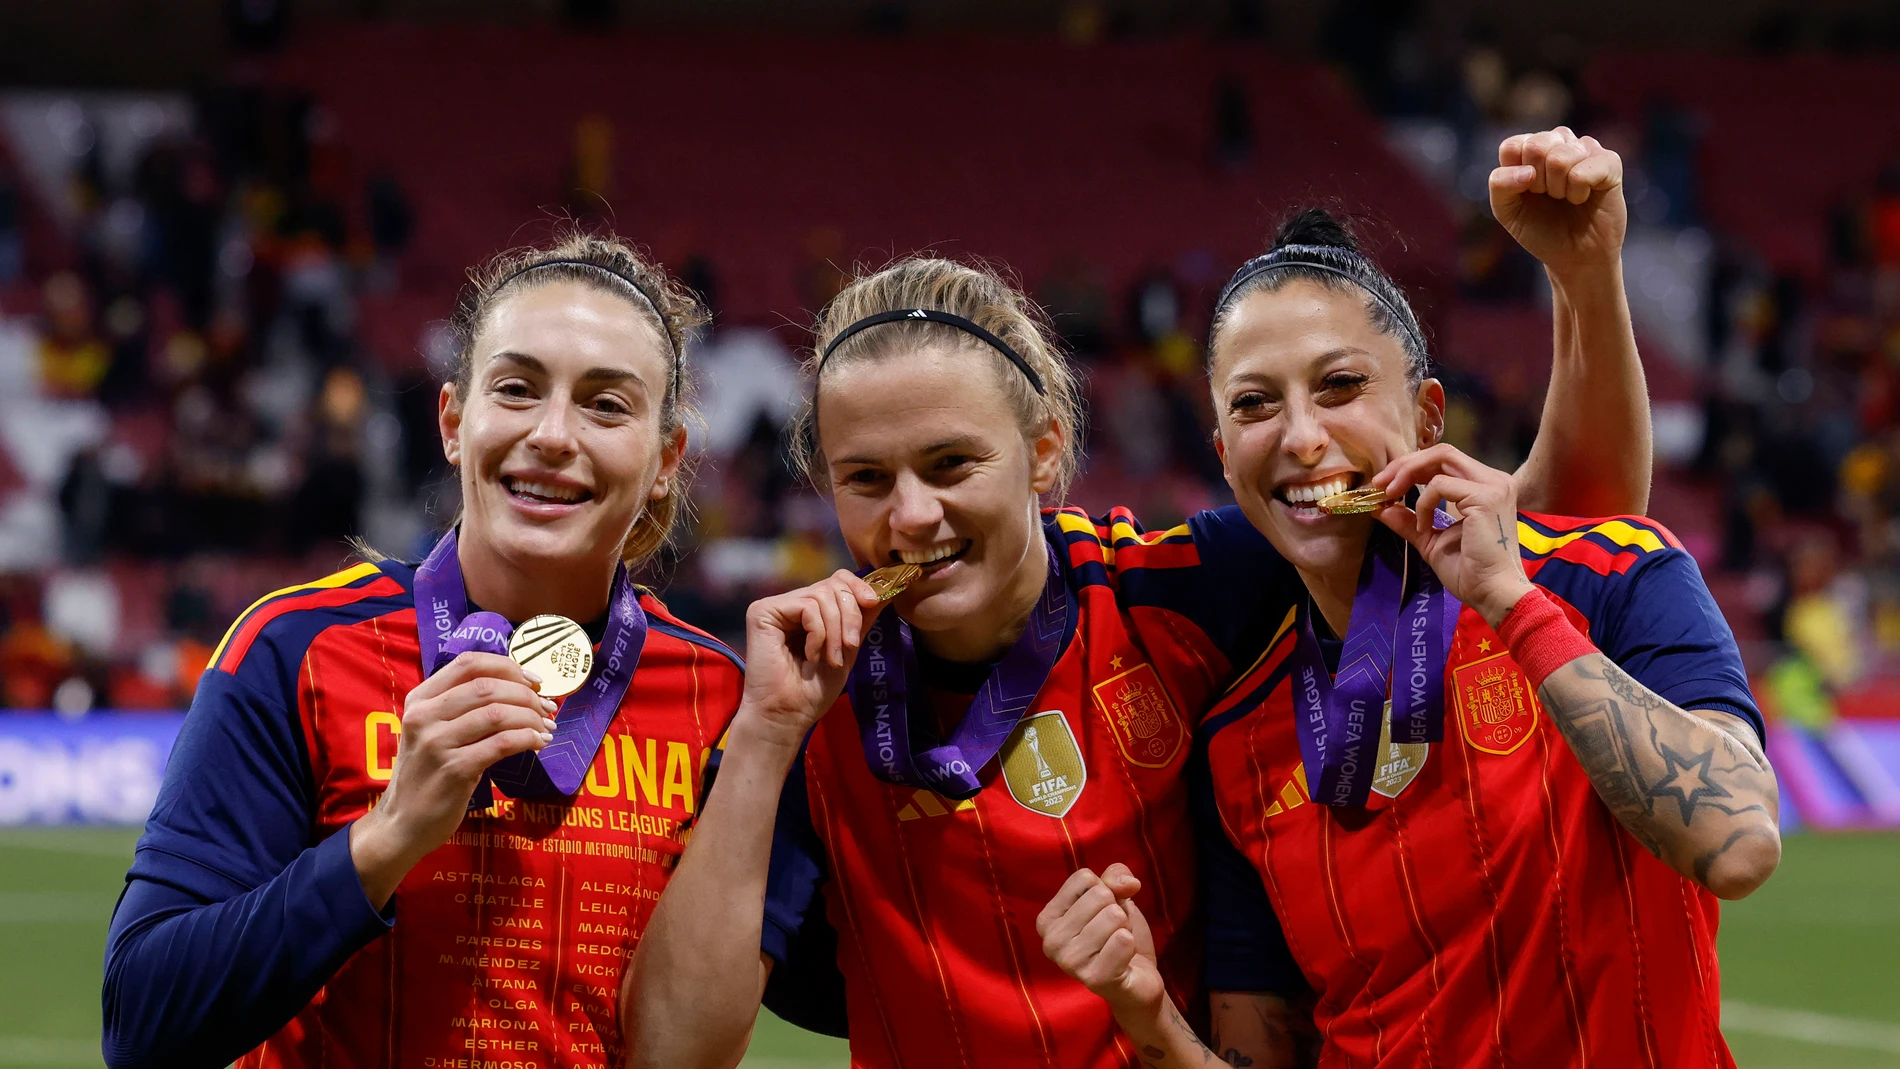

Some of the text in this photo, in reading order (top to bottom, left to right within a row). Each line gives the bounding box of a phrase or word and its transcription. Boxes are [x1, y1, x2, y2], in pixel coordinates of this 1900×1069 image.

[433, 599, 452, 653] AGUE
[452, 626, 508, 651] NATION
[562, 642, 575, 678] NATIONS
[569, 647, 581, 678] LEAGUE
[593, 627, 631, 694] LEAGUE
[1410, 616, 1427, 707] WOMEN'S
[1302, 665, 1327, 733] LEAGUE
[1345, 699, 1366, 743] UEFA
[1381, 758, 1409, 777] FIFA
[1031, 776, 1068, 797] FIFA
[1043, 795, 1064, 807] 2023
[523, 802, 603, 829] NATIONS
[608, 809, 672, 839] LEAGUE
[494, 834, 506, 848] DE
[508, 835, 534, 851] 2025
[542, 838, 582, 855] ESTADIO
[584, 841, 658, 865] METROPOLITANO
[433, 871, 546, 888] ASTRALAGA
[580, 881, 661, 901] ALEIXAND
[454, 893, 545, 909] O.BATLLE
[580, 901, 628, 917] LEILA
[492, 916, 544, 930] JANA
[578, 922, 629, 938] MARÍA
[456, 935, 542, 950] PAREDES
[577, 943, 636, 959] REDOND
[472, 978, 538, 990] AITANA
[572, 984, 607, 998] EVA
[489, 998, 538, 1011] OLGA
[451, 1017, 540, 1031] MARIONA
[464, 1038, 539, 1052] ESTHER
